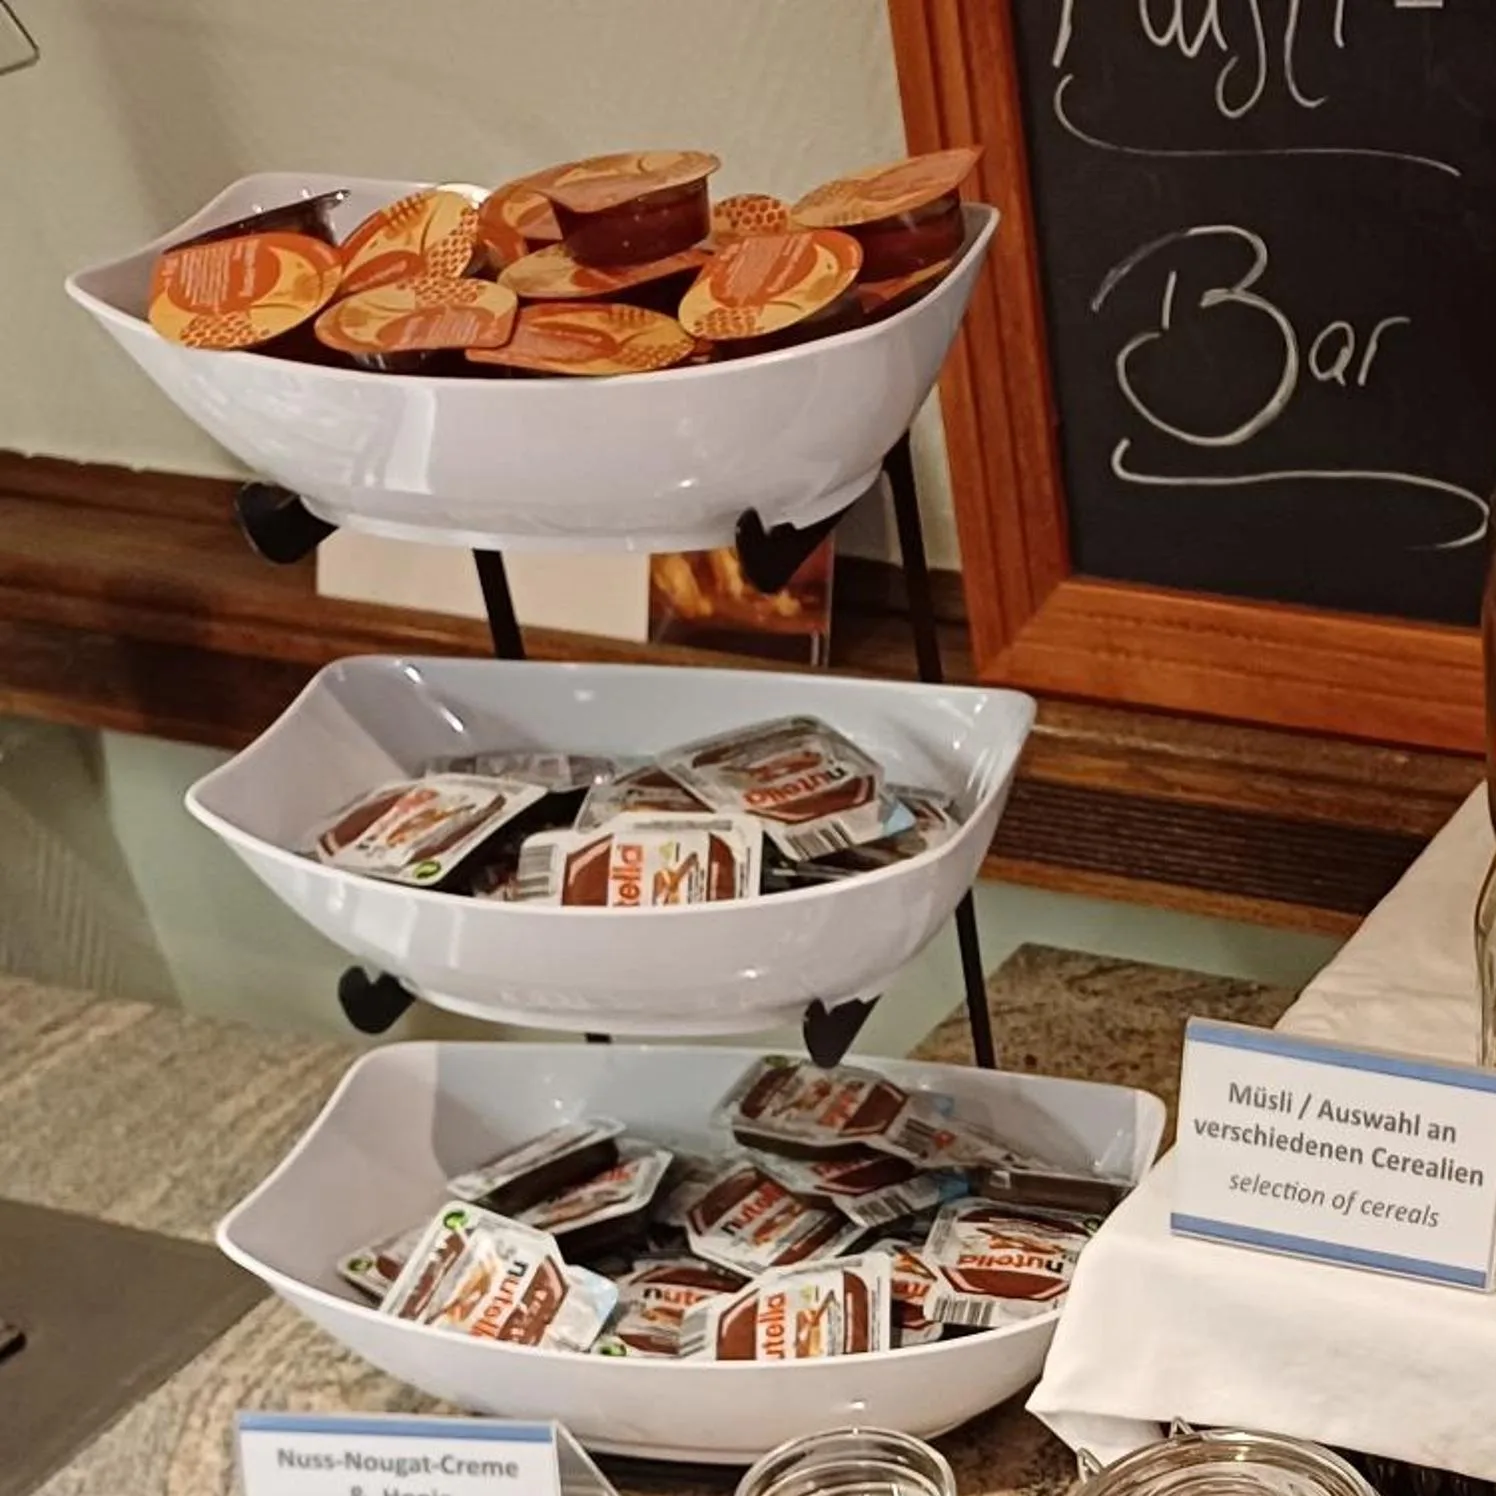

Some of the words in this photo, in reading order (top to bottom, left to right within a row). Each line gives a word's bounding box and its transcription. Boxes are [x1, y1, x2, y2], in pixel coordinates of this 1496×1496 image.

[1091, 224, 1411, 447] Bar
[1228, 1081, 1292, 1114] Müsli
[1299, 1093, 1312, 1119] /
[1317, 1099, 1420, 1137] Auswahl
[1427, 1121, 1457, 1143] an
[1193, 1117, 1364, 1165] verschiedenen
[1371, 1146, 1485, 1187] Cerealien
[1229, 1171, 1325, 1207] selection
[1331, 1189, 1356, 1216] of
[1360, 1198, 1440, 1228] cereals
[759, 1291, 786, 1360] utella
[276, 1449, 520, 1478] Nuss-Nougat-Creme
